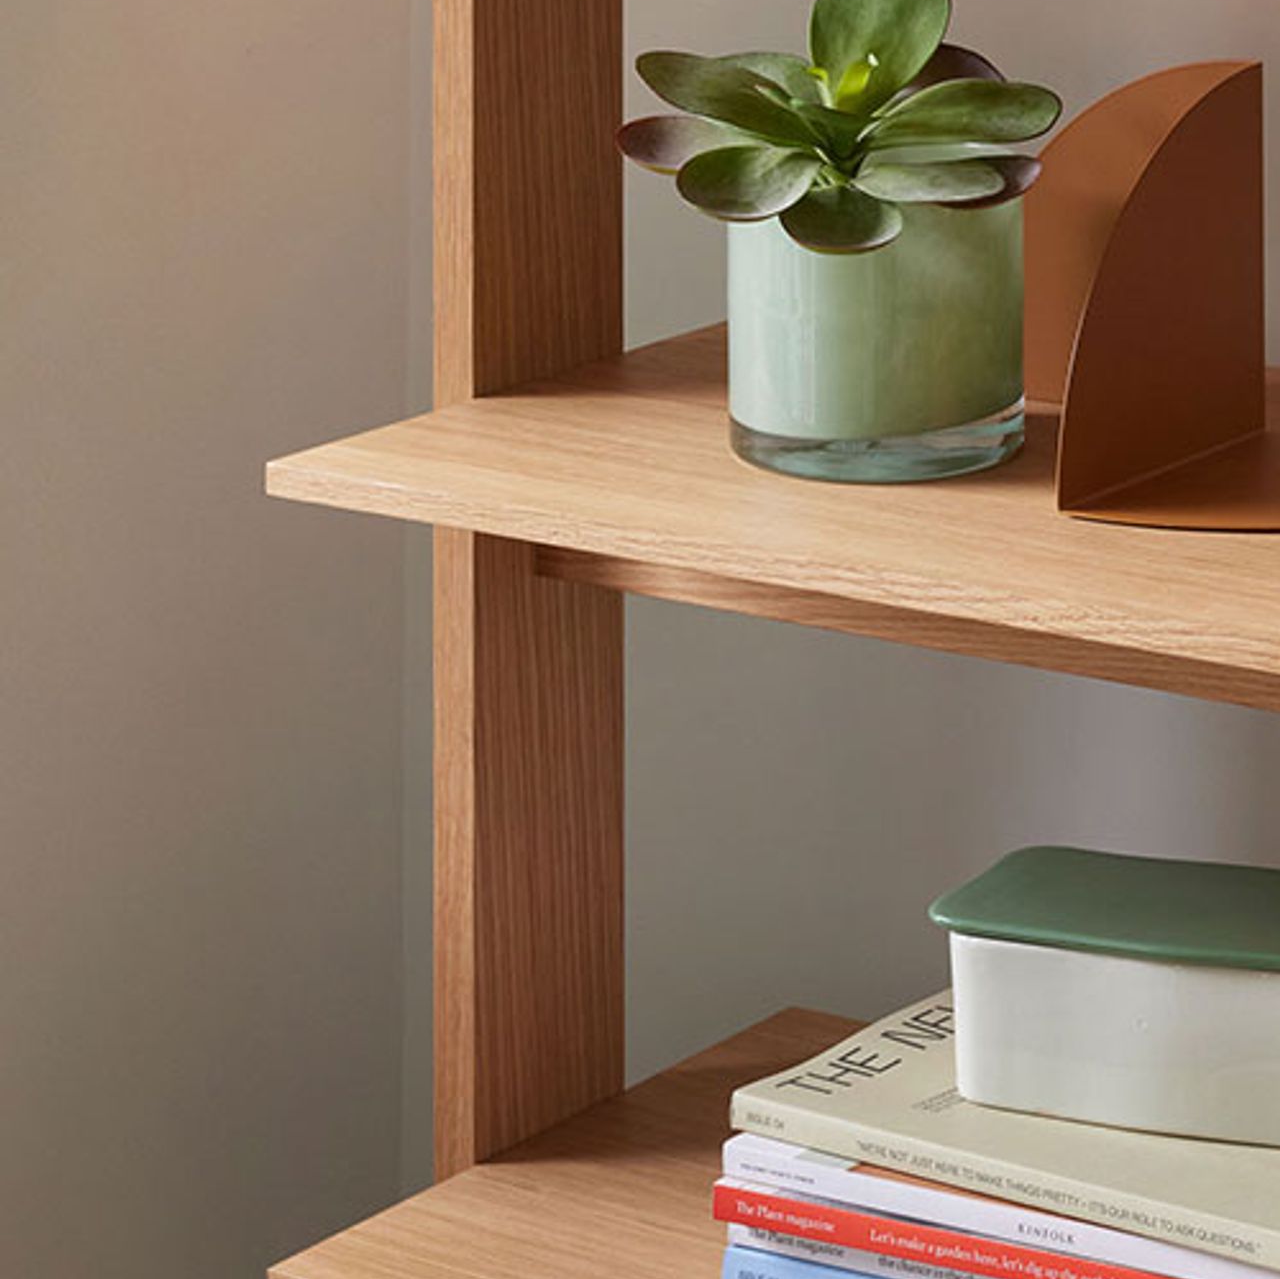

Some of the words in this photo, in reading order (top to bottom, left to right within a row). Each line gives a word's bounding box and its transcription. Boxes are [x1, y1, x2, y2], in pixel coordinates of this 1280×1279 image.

[775, 1046, 902, 1095] THE
[881, 1006, 954, 1049] NE
[736, 1198, 754, 1216] The
[757, 1203, 783, 1222] Plant
[785, 1214, 836, 1233] magazine
[749, 1226, 766, 1240] The
[768, 1230, 793, 1246] Plant
[795, 1237, 844, 1258] magazine
[1017, 1223, 1074, 1245] KINFOLK
[869, 1227, 896, 1246] Let's
[897, 1233, 925, 1252] make
[927, 1243, 933, 1253] a
[1024, 1259, 1042, 1279] dig
